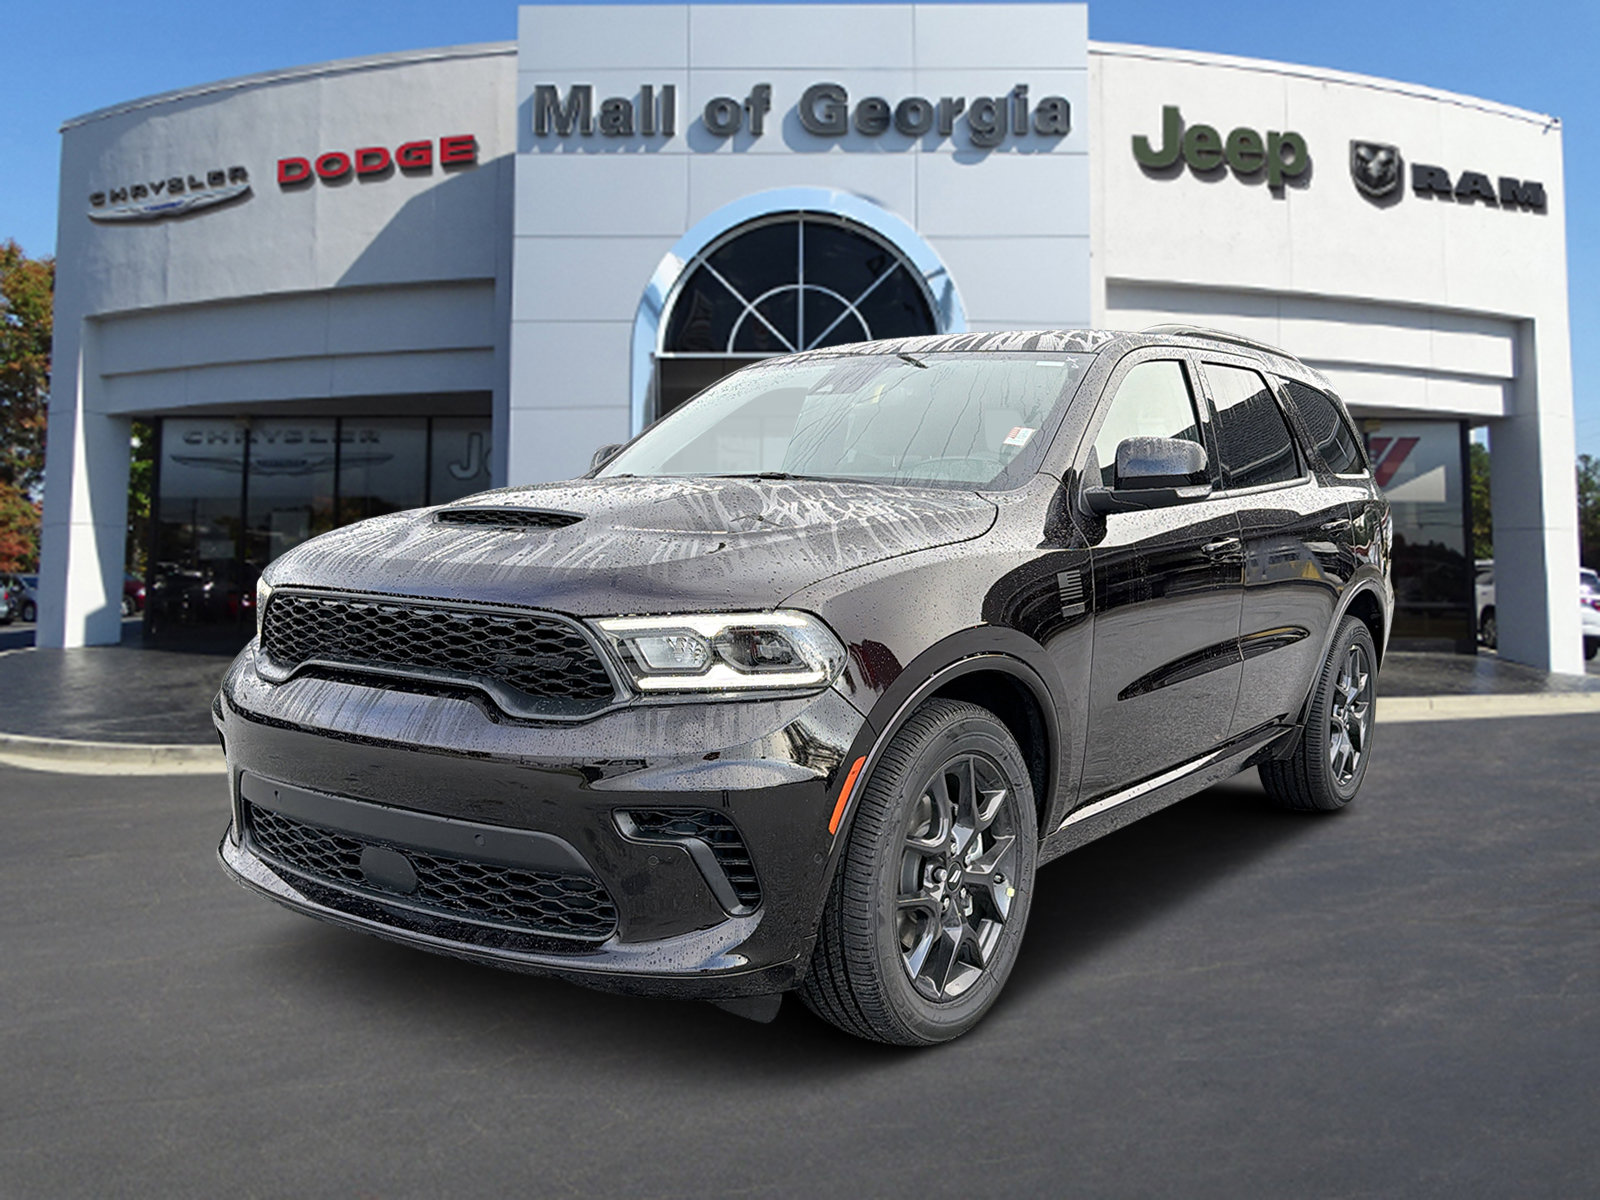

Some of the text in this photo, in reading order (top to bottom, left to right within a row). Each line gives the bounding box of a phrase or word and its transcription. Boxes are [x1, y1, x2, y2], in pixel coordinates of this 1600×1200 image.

[531, 84, 1072, 148] Mall of Georgia
[278, 135, 477, 188] DODGE
[1132, 105, 1310, 192] Jeep
[89, 165, 249, 207] CHRYSLER
[1411, 163, 1546, 212] RAM
